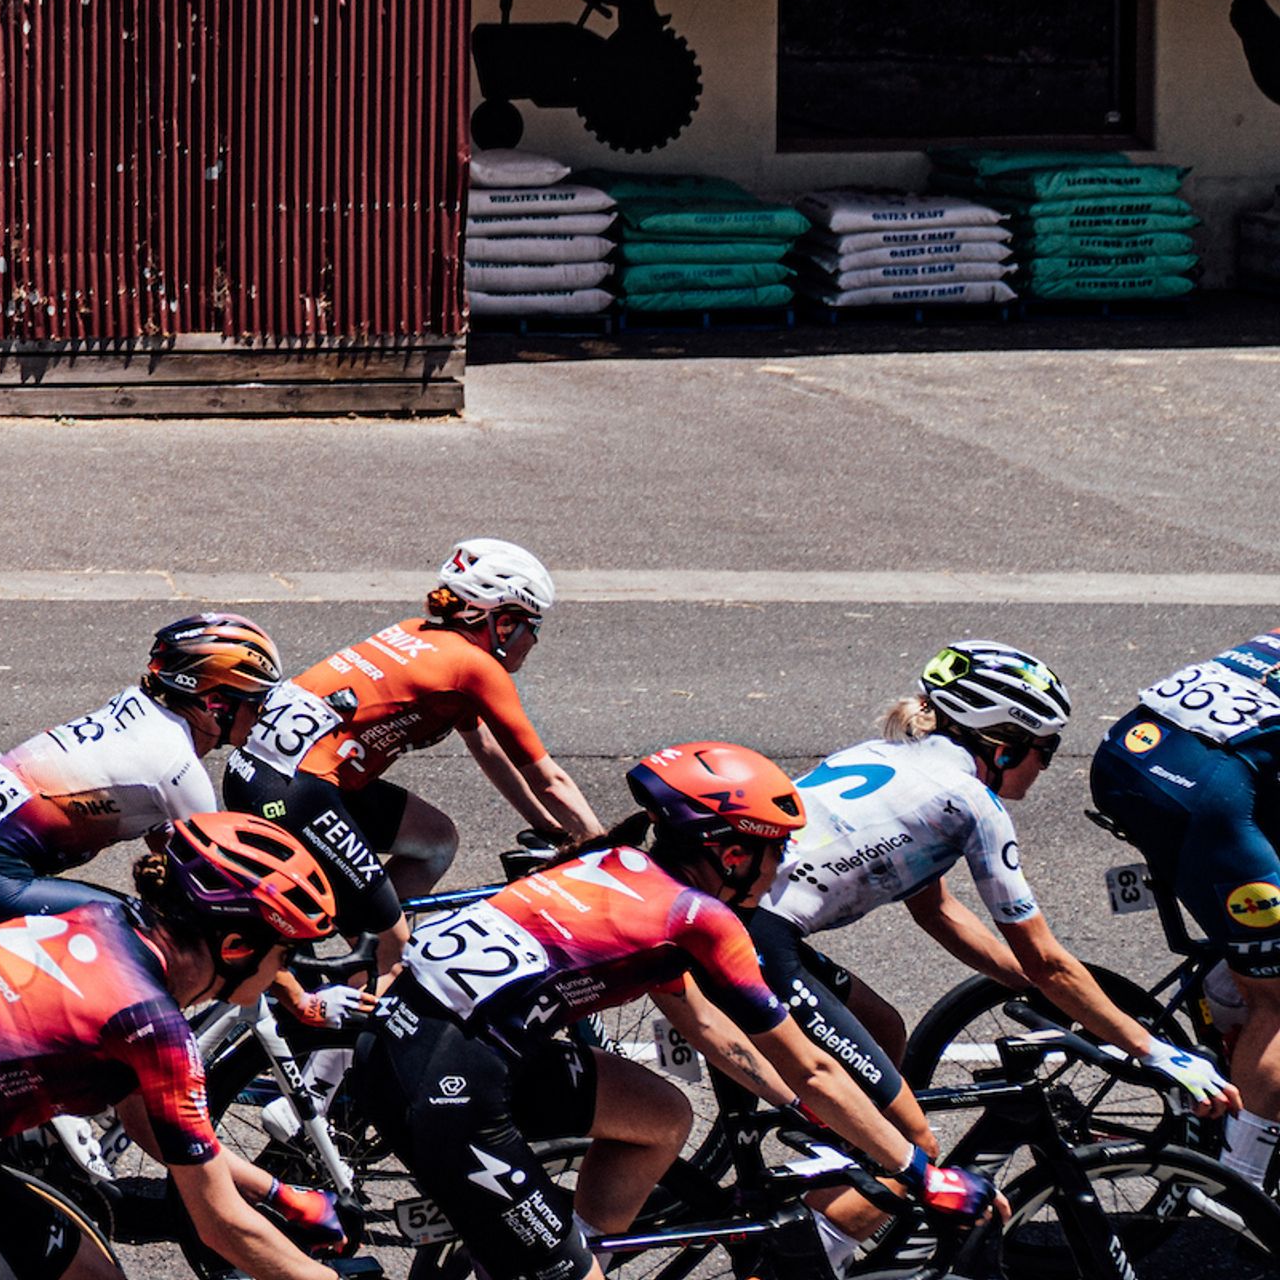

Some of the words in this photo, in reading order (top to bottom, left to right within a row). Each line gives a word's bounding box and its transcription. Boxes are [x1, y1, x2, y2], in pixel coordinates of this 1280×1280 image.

[490, 194, 539, 204] WHEATEN
[543, 192, 576, 201] CHAFF
[872, 212, 907, 221] OATEN
[910, 209, 944, 220] CHAFF
[883, 234, 918, 243] OATEN
[921, 231, 956, 241] CHAFF
[889, 249, 924, 258] OATEN
[928, 245, 962, 255] CHAFF
[882, 267, 918, 276] OATEN
[921, 264, 956, 275] CHAFF
[892, 289, 928, 299] OATEN
[931, 286, 965, 296] CHAFF
[259, 701, 319, 757] 43
[359, 712, 422, 744] PREMIER
[372, 729, 407, 753] TECH
[1149, 764, 1198, 790] Santini
[739, 819, 781, 836] SMITH
[312, 809, 382, 883] FENIX
[821, 830, 915, 878] Telefónica
[1118, 870, 1141, 904] 63
[268, 911, 297, 936] SMITH
[667, 1027, 692, 1067] 86
[807, 1011, 883, 1085] Telefónica
[408, 1199, 440, 1228] 52
[515, 1201, 561, 1249] Powered
[528, 1190, 563, 1232] Human
[501, 1209, 537, 1247] Health
